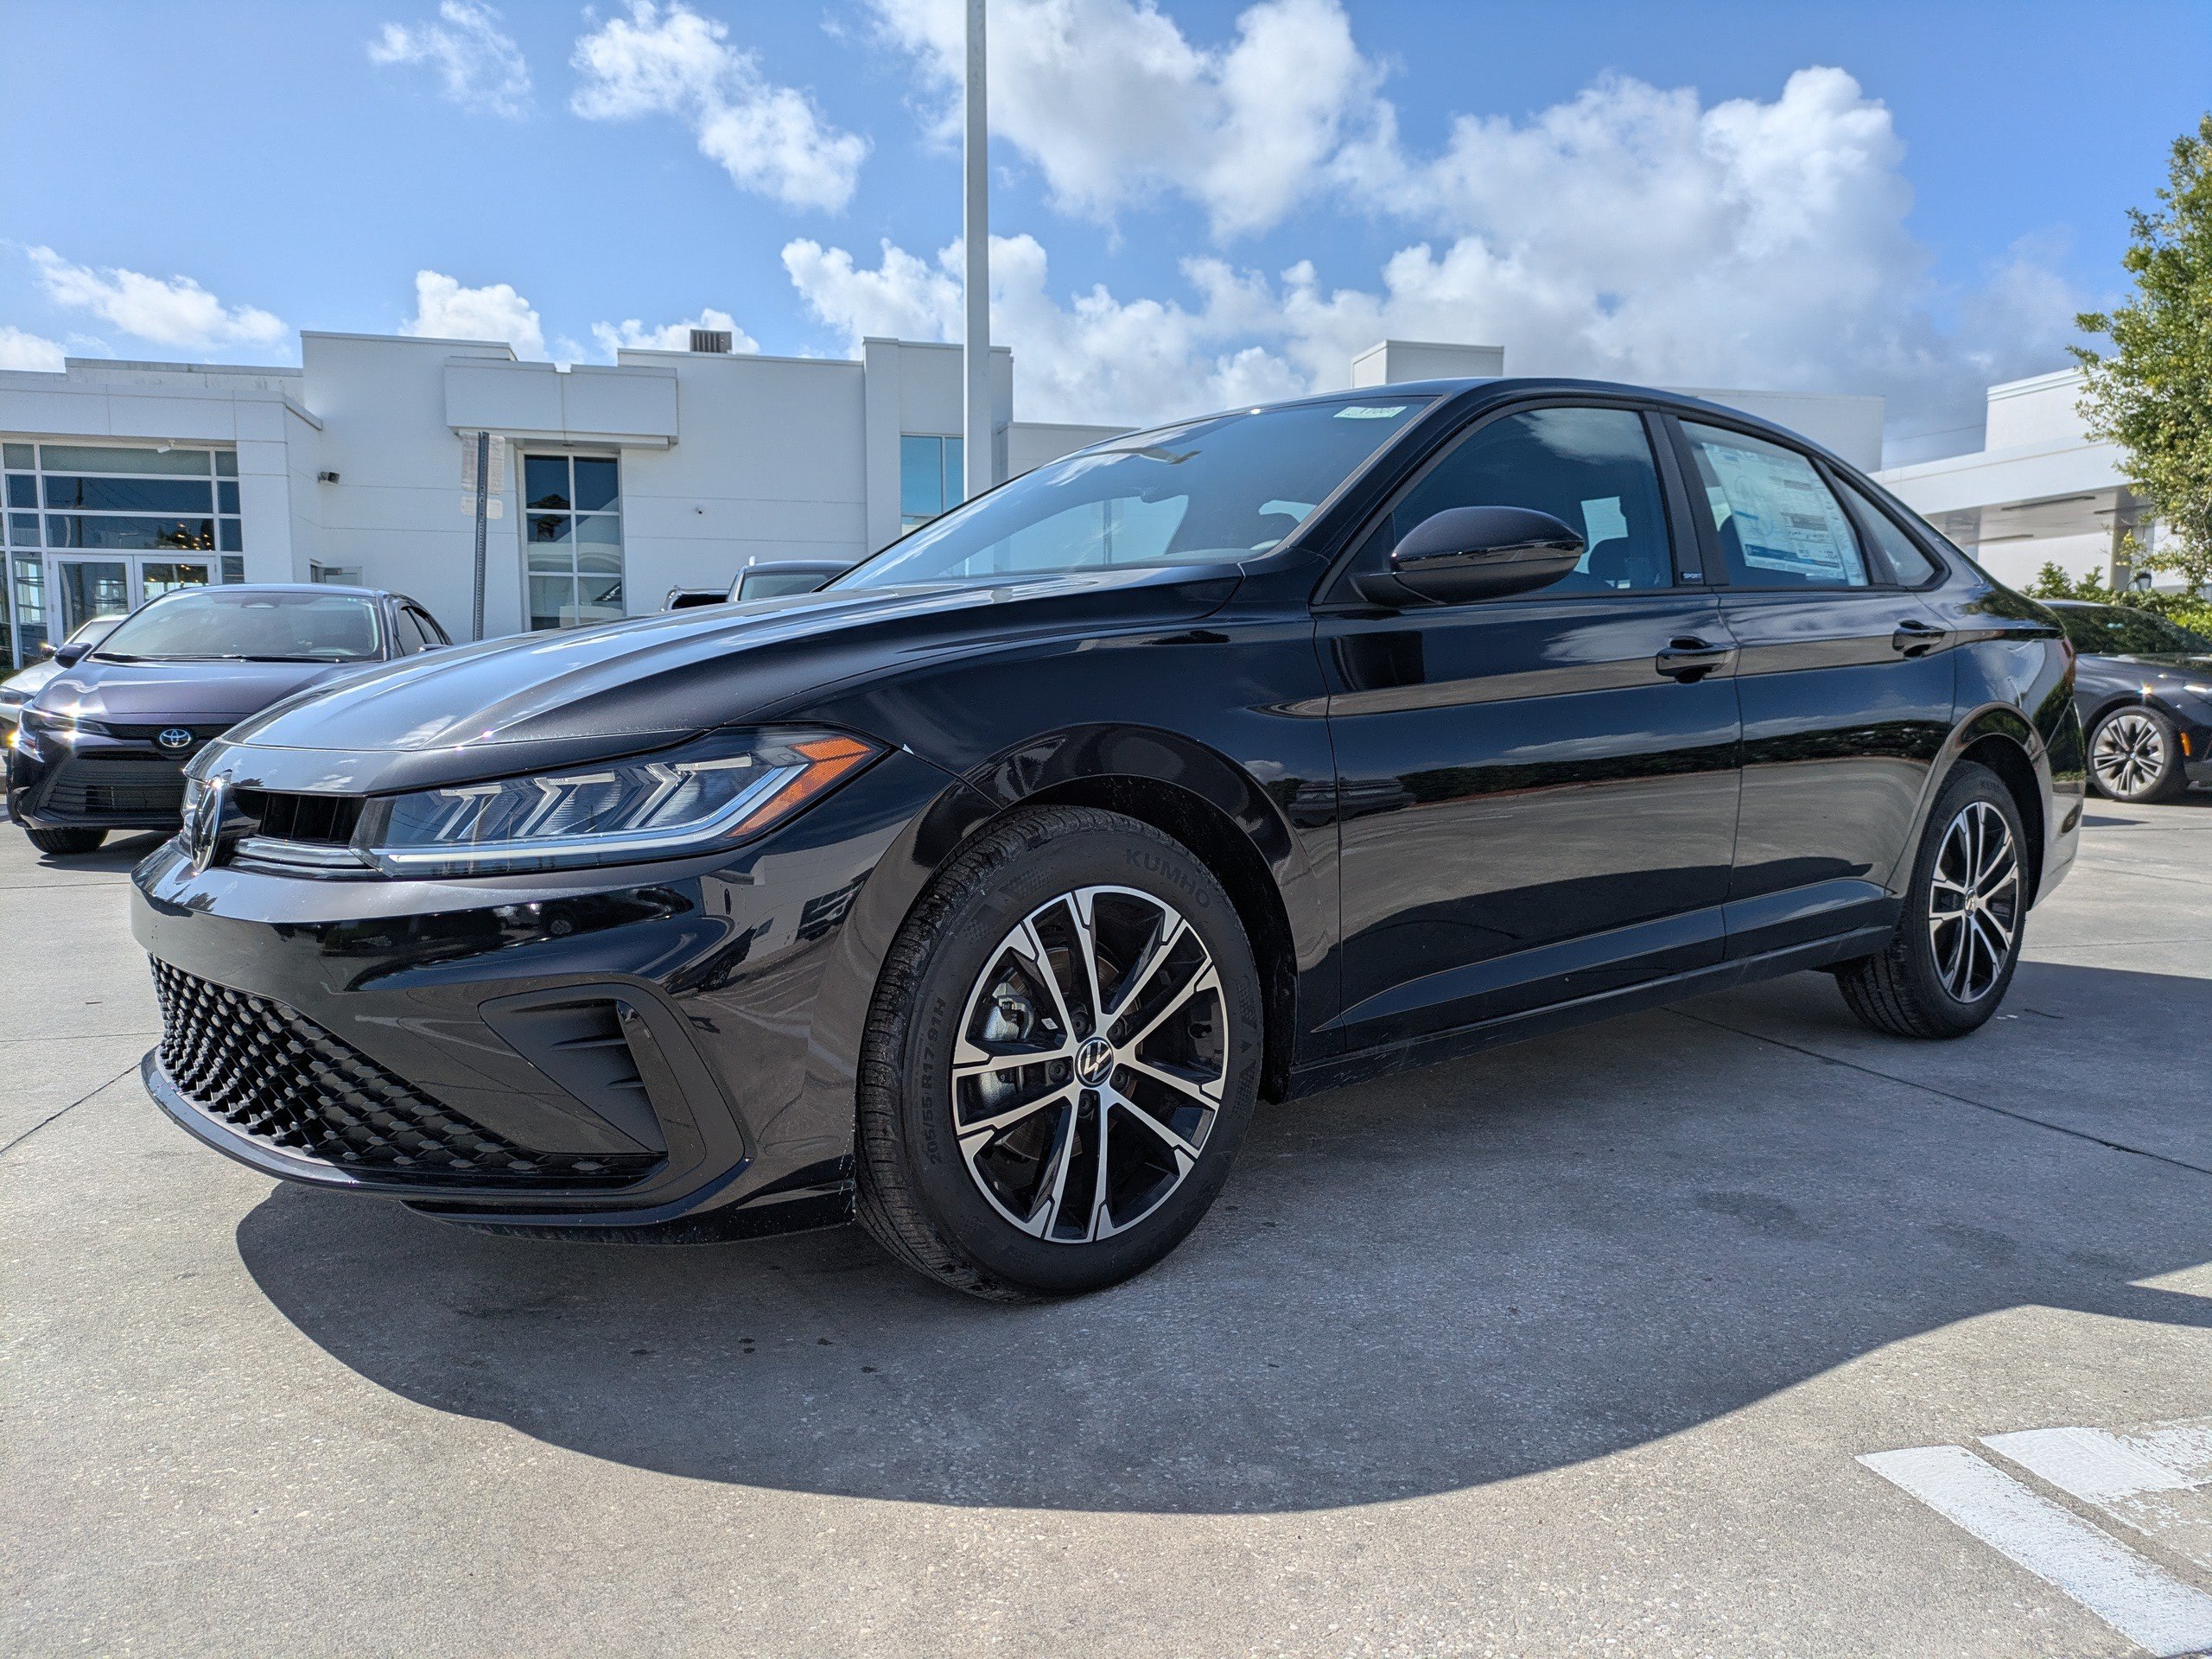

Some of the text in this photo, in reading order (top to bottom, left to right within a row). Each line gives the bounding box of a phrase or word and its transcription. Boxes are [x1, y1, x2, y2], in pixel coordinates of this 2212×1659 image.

[1124, 848, 1211, 907] KUMHO
[921, 997, 947, 1167] 205/55 R17 91H
